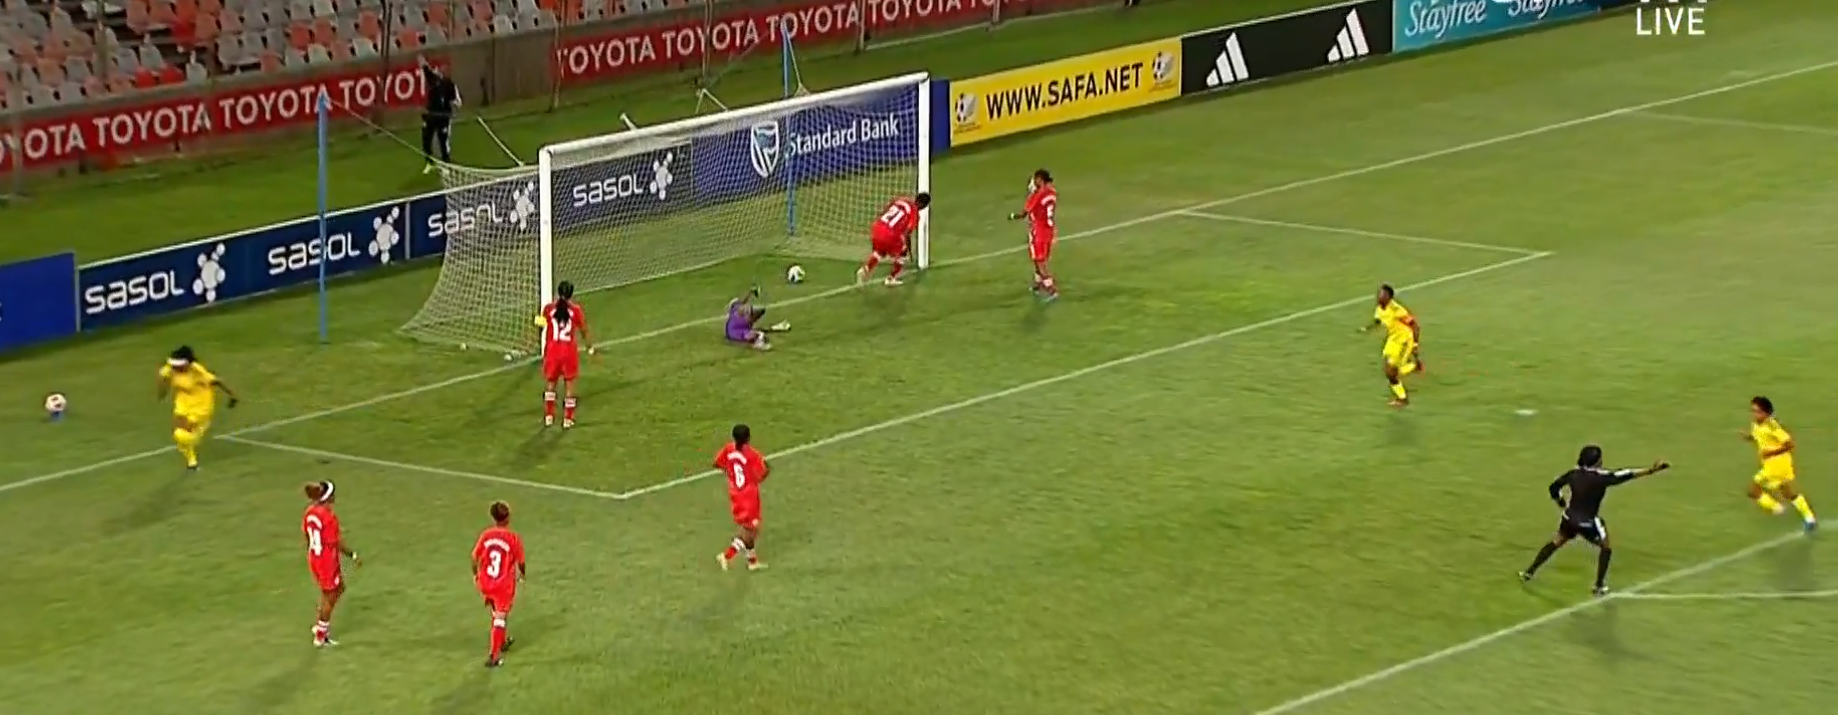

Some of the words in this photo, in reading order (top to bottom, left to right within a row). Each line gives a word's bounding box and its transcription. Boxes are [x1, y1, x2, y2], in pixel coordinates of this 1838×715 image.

[1405, 0, 1487, 39] Stayfree
[662, 17, 760, 60] TOYOTA
[986, 62, 1143, 119] WWW.SAFA.NET
[93, 103, 211, 147] TOYOTA
[219, 83, 333, 129] TOYOTA
[784, 121, 857, 158] Standard
[861, 113, 899, 142] Bank
[880, 205, 905, 228] 21
[551, 318, 573, 342] 12
[733, 463, 746, 488] 6
[306, 526, 323, 556] 14
[486, 550, 502, 579] 3
